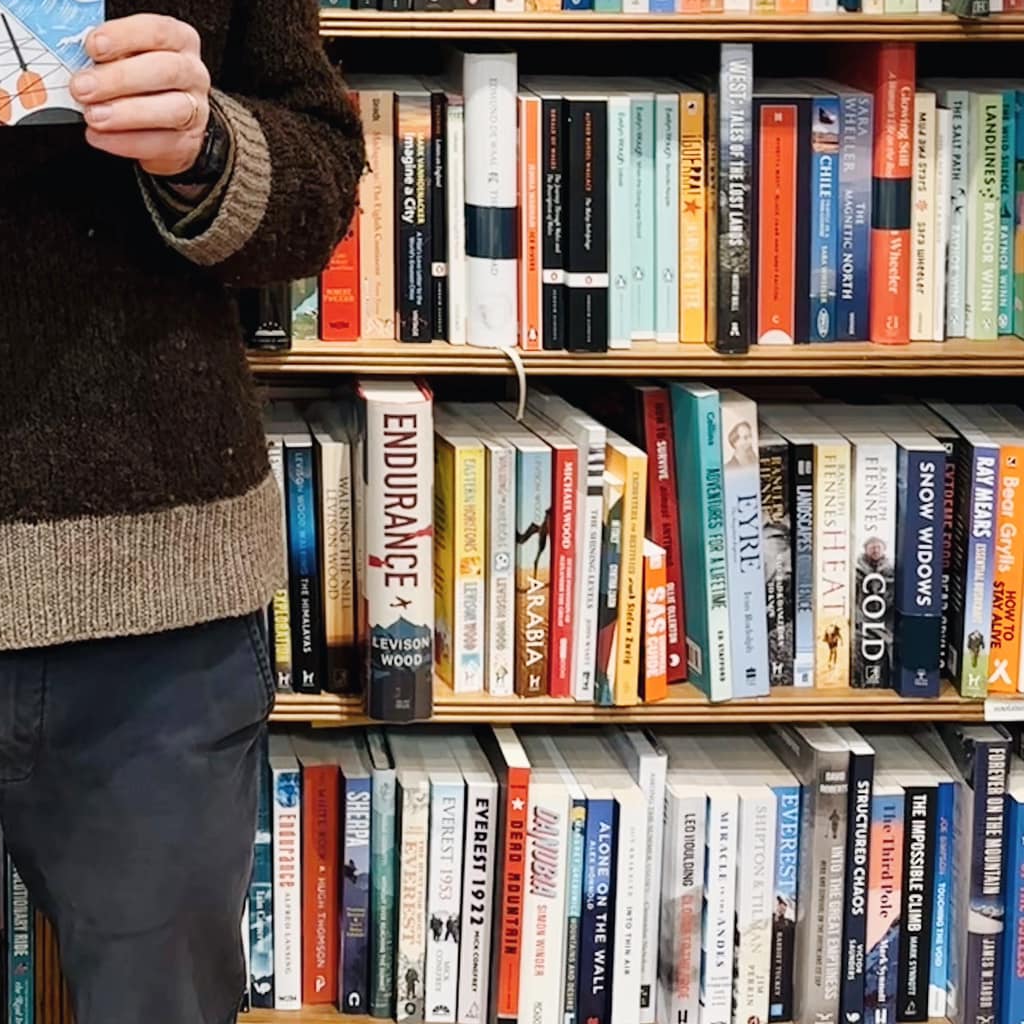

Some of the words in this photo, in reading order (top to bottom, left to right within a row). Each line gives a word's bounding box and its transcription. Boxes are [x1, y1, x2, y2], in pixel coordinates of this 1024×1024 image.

[985, 106, 997, 188] LANDLINES
[820, 155, 832, 198] CHILE
[984, 205, 994, 261] RAYNOR
[982, 269, 994, 311] WINN
[919, 462, 934, 519] SNOW
[976, 457, 996, 487] RAY
[384, 414, 418, 587] ENDURANCE
[973, 488, 994, 538] MEARS
[1002, 477, 1019, 517] Bear
[737, 493, 761, 574] EYRE
[997, 523, 1017, 573] Grylls
[917, 526, 934, 606] WIDOWS
[862, 574, 886, 661] COLD
[993, 581, 1005, 611] STAY
[1005, 591, 1016, 620] HOW
[373, 636, 429, 650] LEVISON
[525, 577, 545, 666] ARABIA
[991, 614, 1002, 649] ALIVE
[1004, 622, 1014, 641] TO
[381, 654, 422, 667] WOOD
[855, 781, 869, 865] STRUCTURED
[912, 795, 925, 816] THE
[440, 797, 456, 863] EVEREST
[473, 798, 489, 873] EVEREST
[509, 821, 522, 863] DEAD
[598, 822, 613, 878] ALONE
[779, 795, 799, 895] EVEREST
[911, 818, 925, 895] IMPOSSIBLE
[470, 880, 486, 927] 1922
[503, 872, 520, 955] MOUNTAIN
[596, 884, 610, 907] ON
[852, 868, 865, 915] CHAOS
[909, 896, 922, 931] CLIMB
[595, 913, 607, 943] THE
[593, 948, 607, 995] WALL
